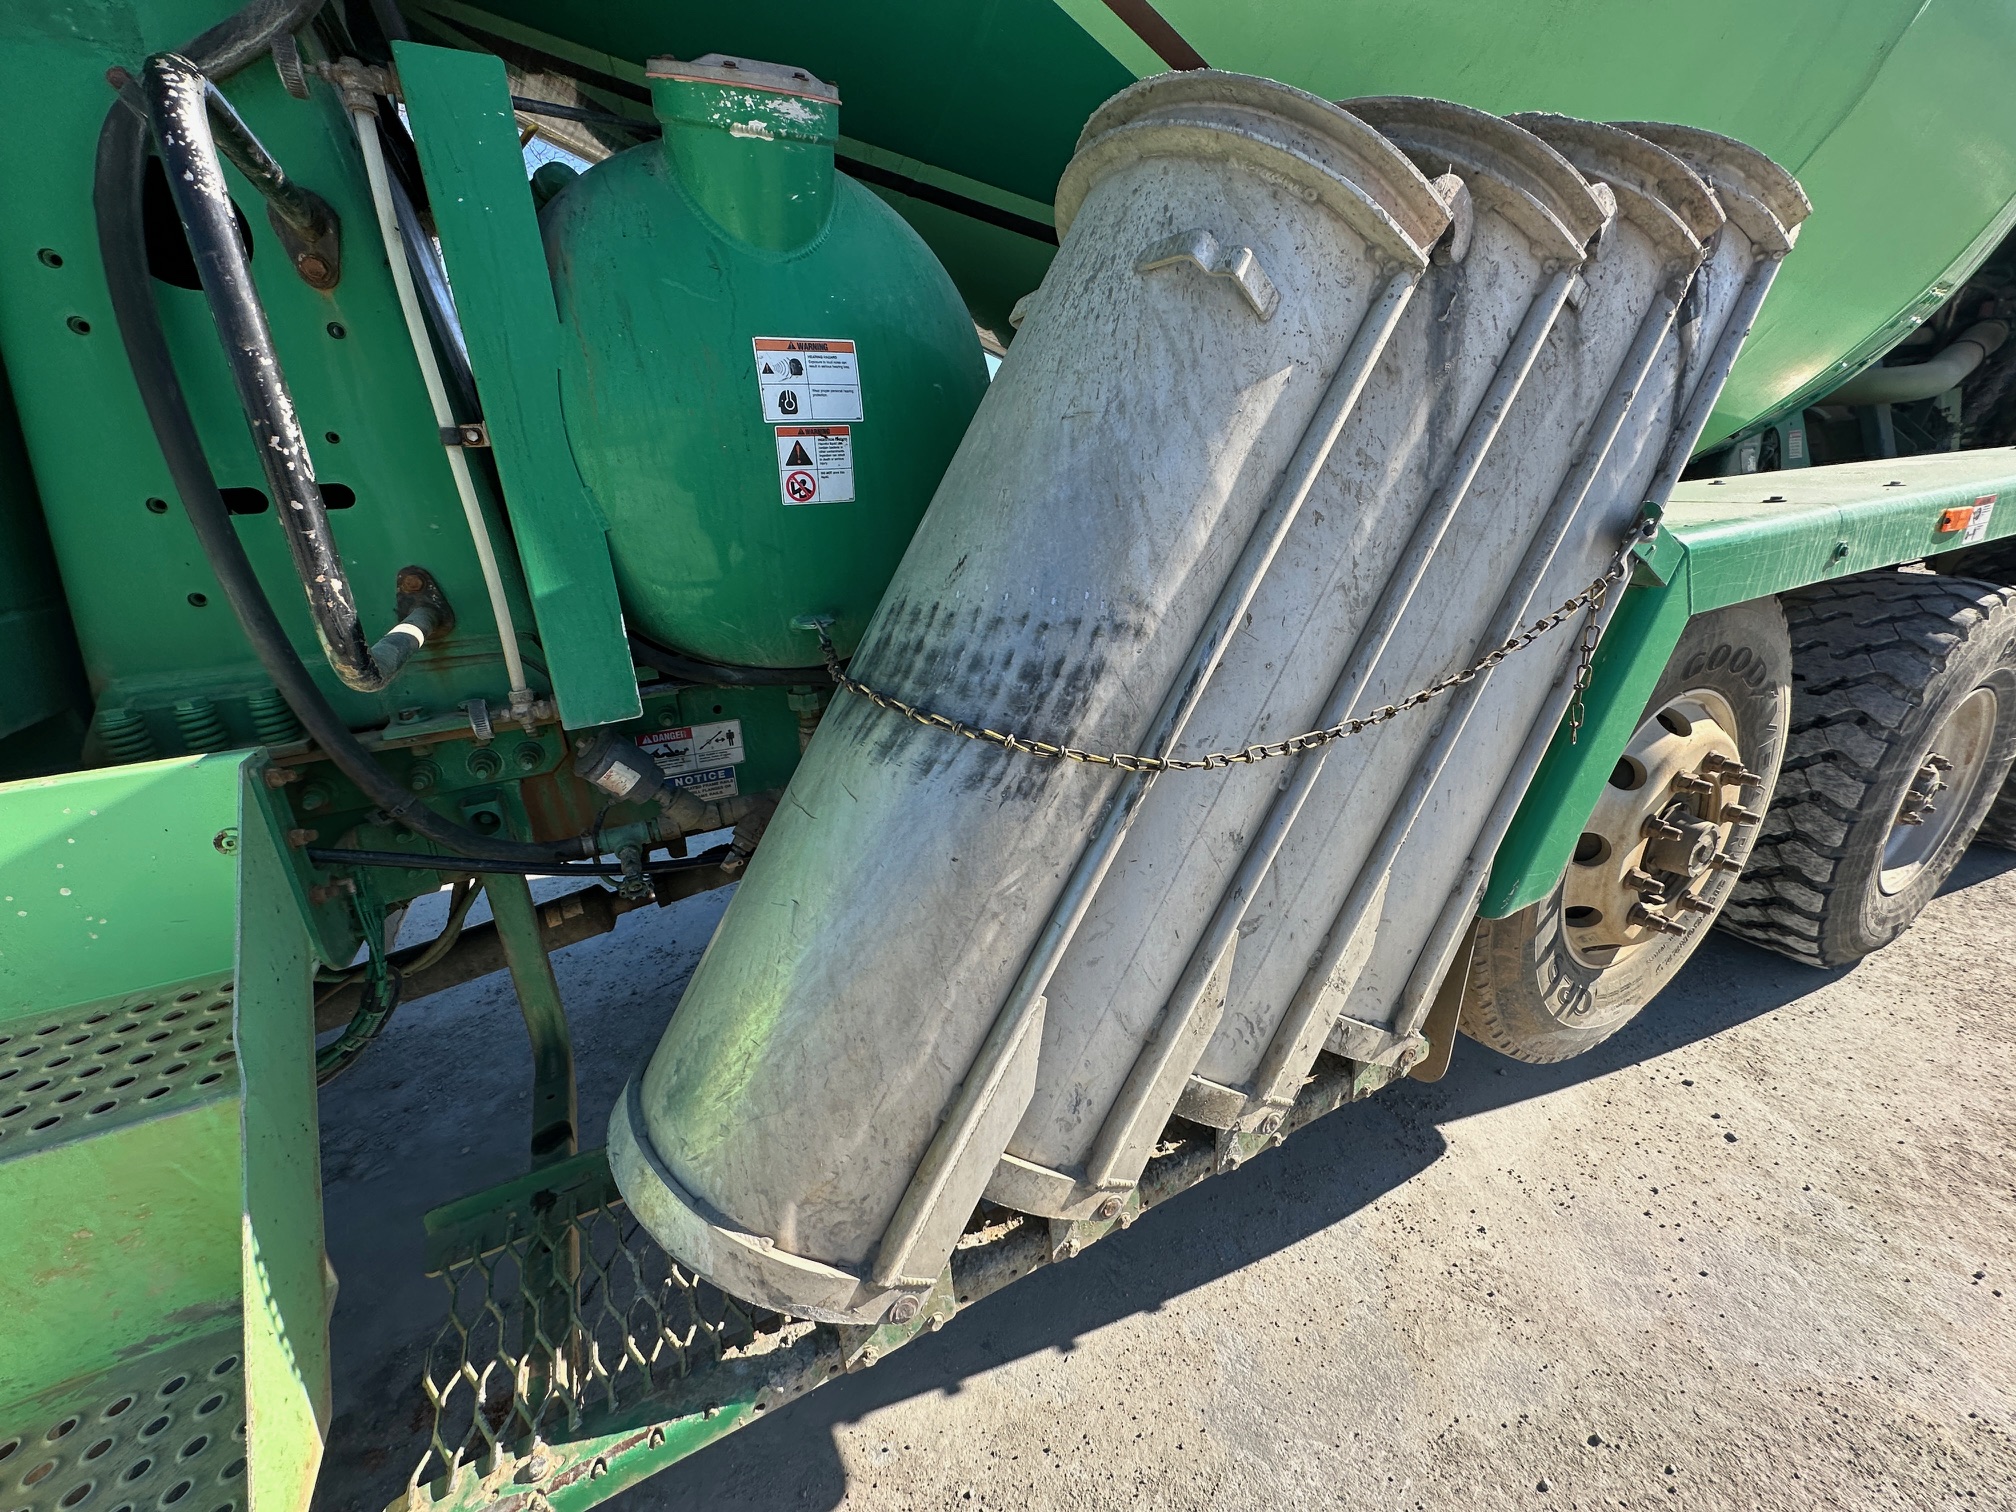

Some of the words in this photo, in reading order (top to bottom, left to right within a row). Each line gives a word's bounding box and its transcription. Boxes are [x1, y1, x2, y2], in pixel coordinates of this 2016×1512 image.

[796, 342, 829, 351] WARNING
[652, 730, 687, 743] DANGER
[674, 770, 726, 787] NOTICE
[702, 781, 719, 789] FRAME
